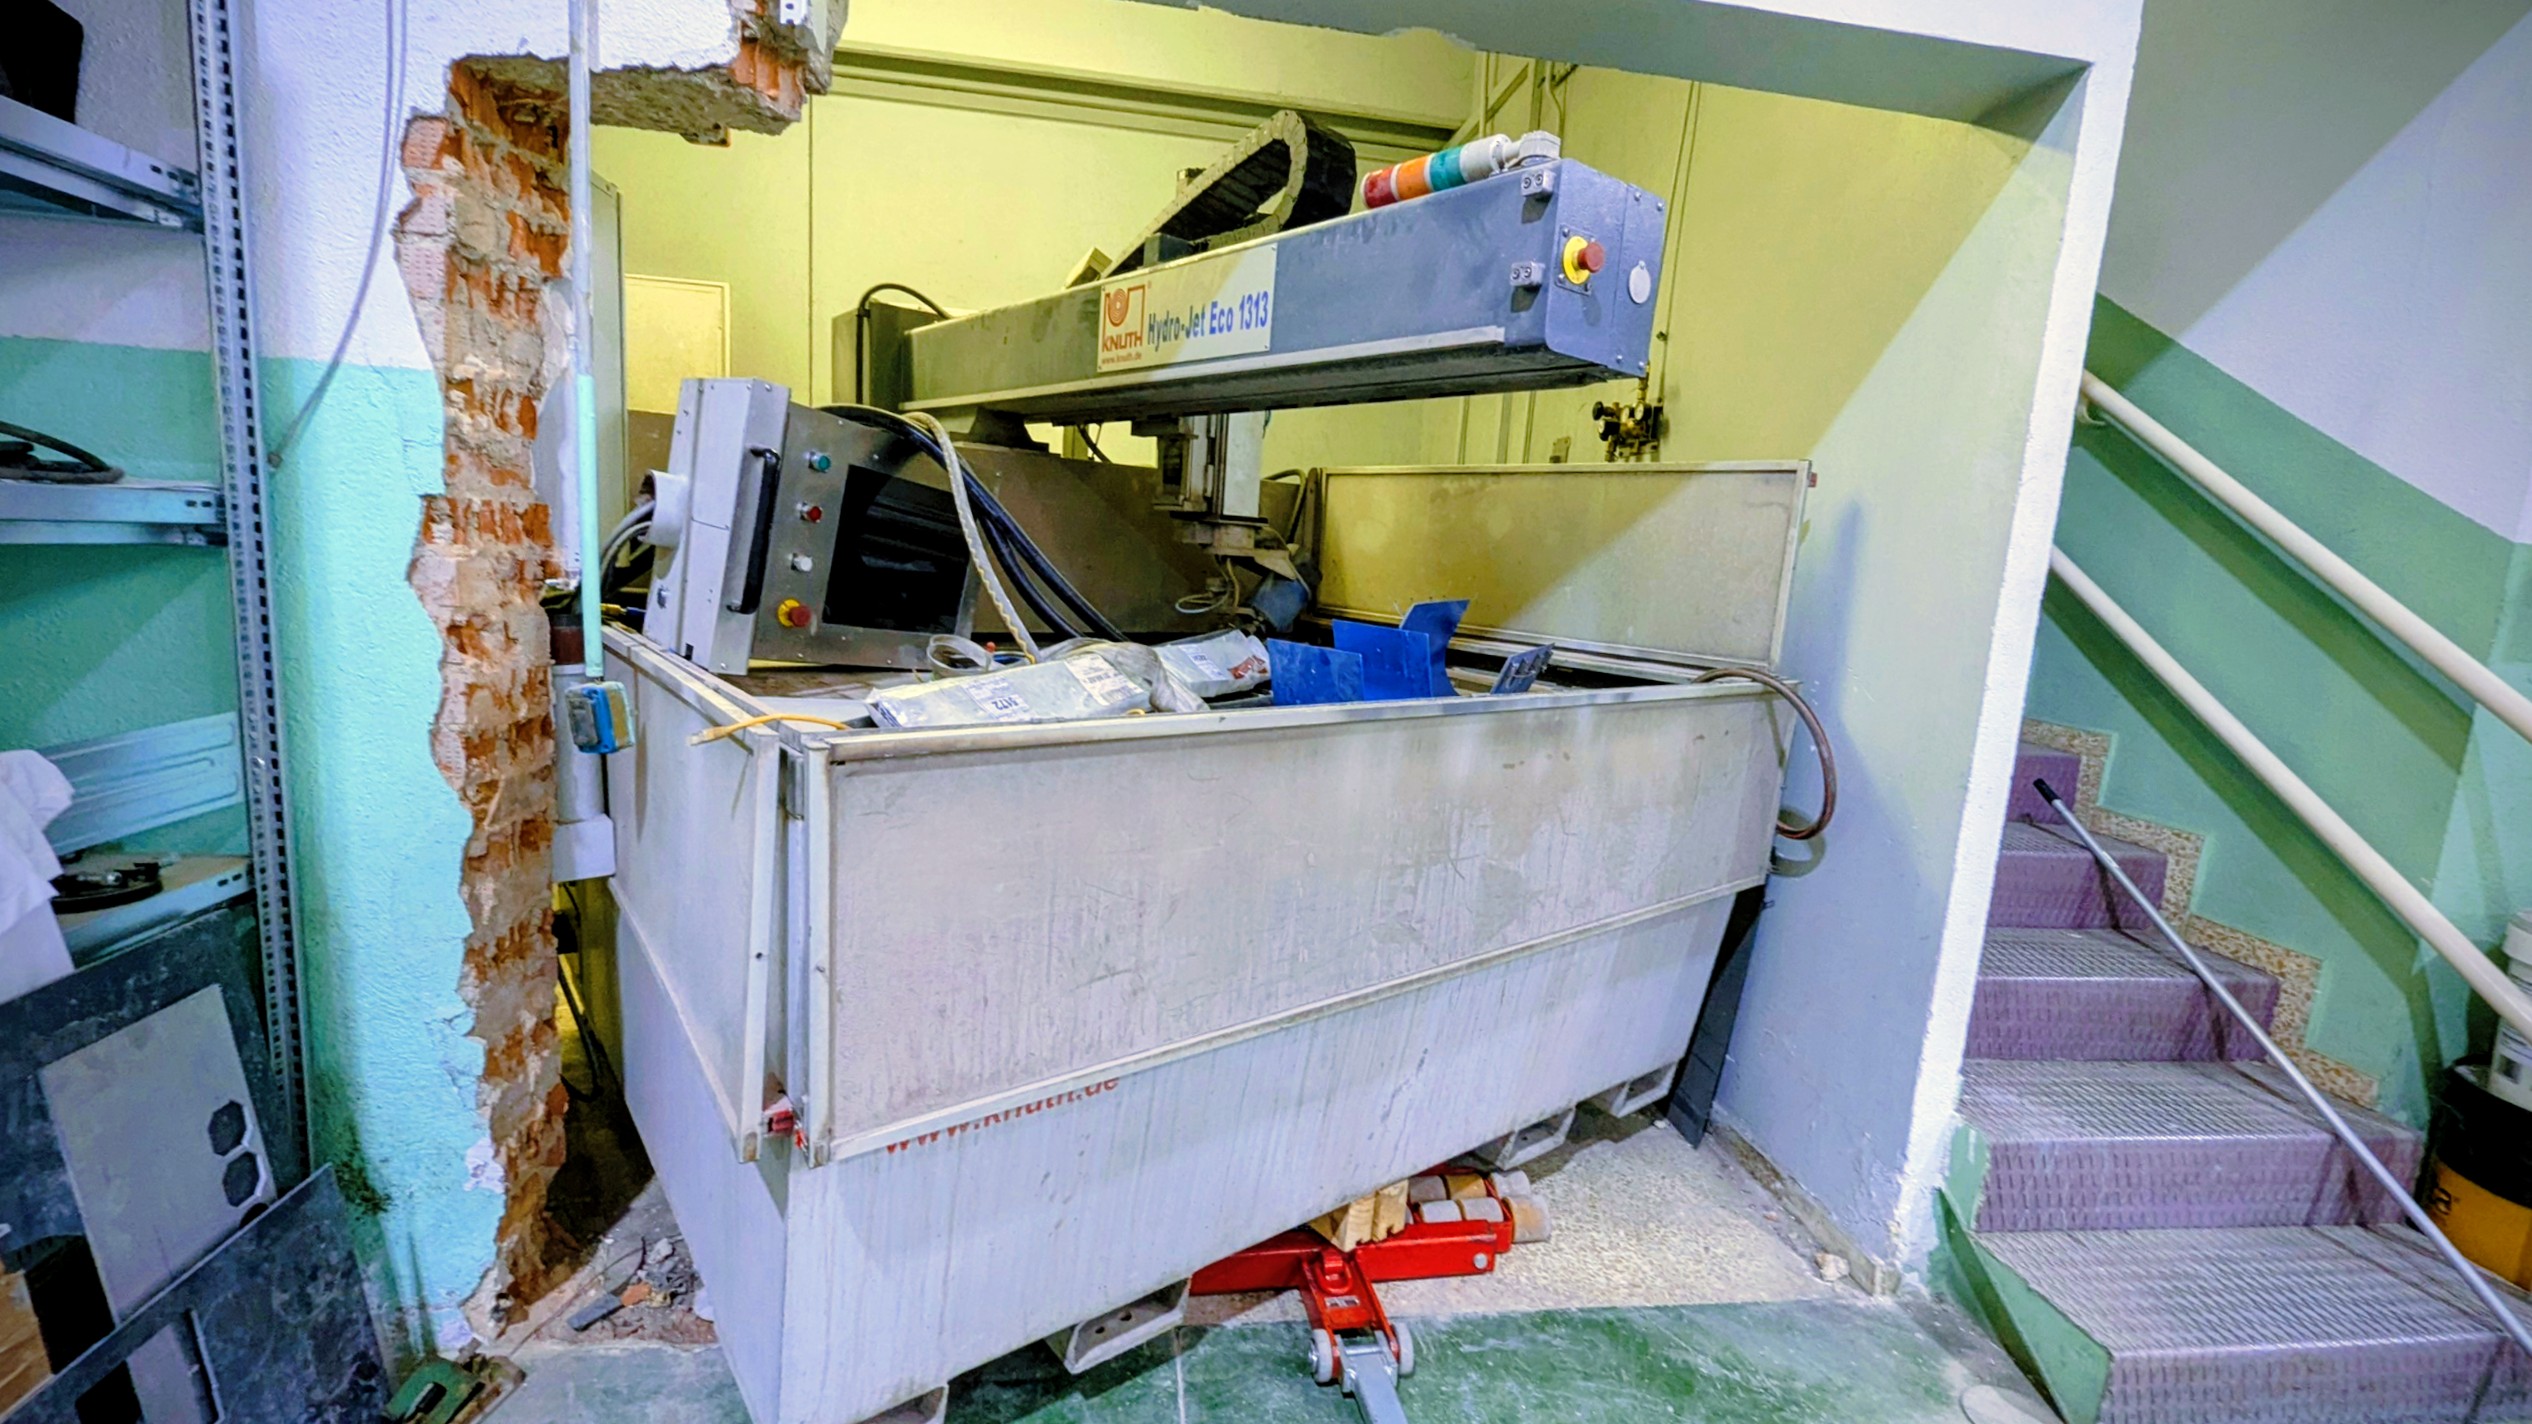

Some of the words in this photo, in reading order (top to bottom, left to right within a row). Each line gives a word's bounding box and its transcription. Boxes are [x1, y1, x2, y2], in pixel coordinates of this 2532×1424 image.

[1102, 331, 1142, 352] KNUTH
[1147, 305, 1206, 352] Hydro-Jet
[1209, 301, 1234, 335] Eco
[1239, 291, 1269, 331] 1313
